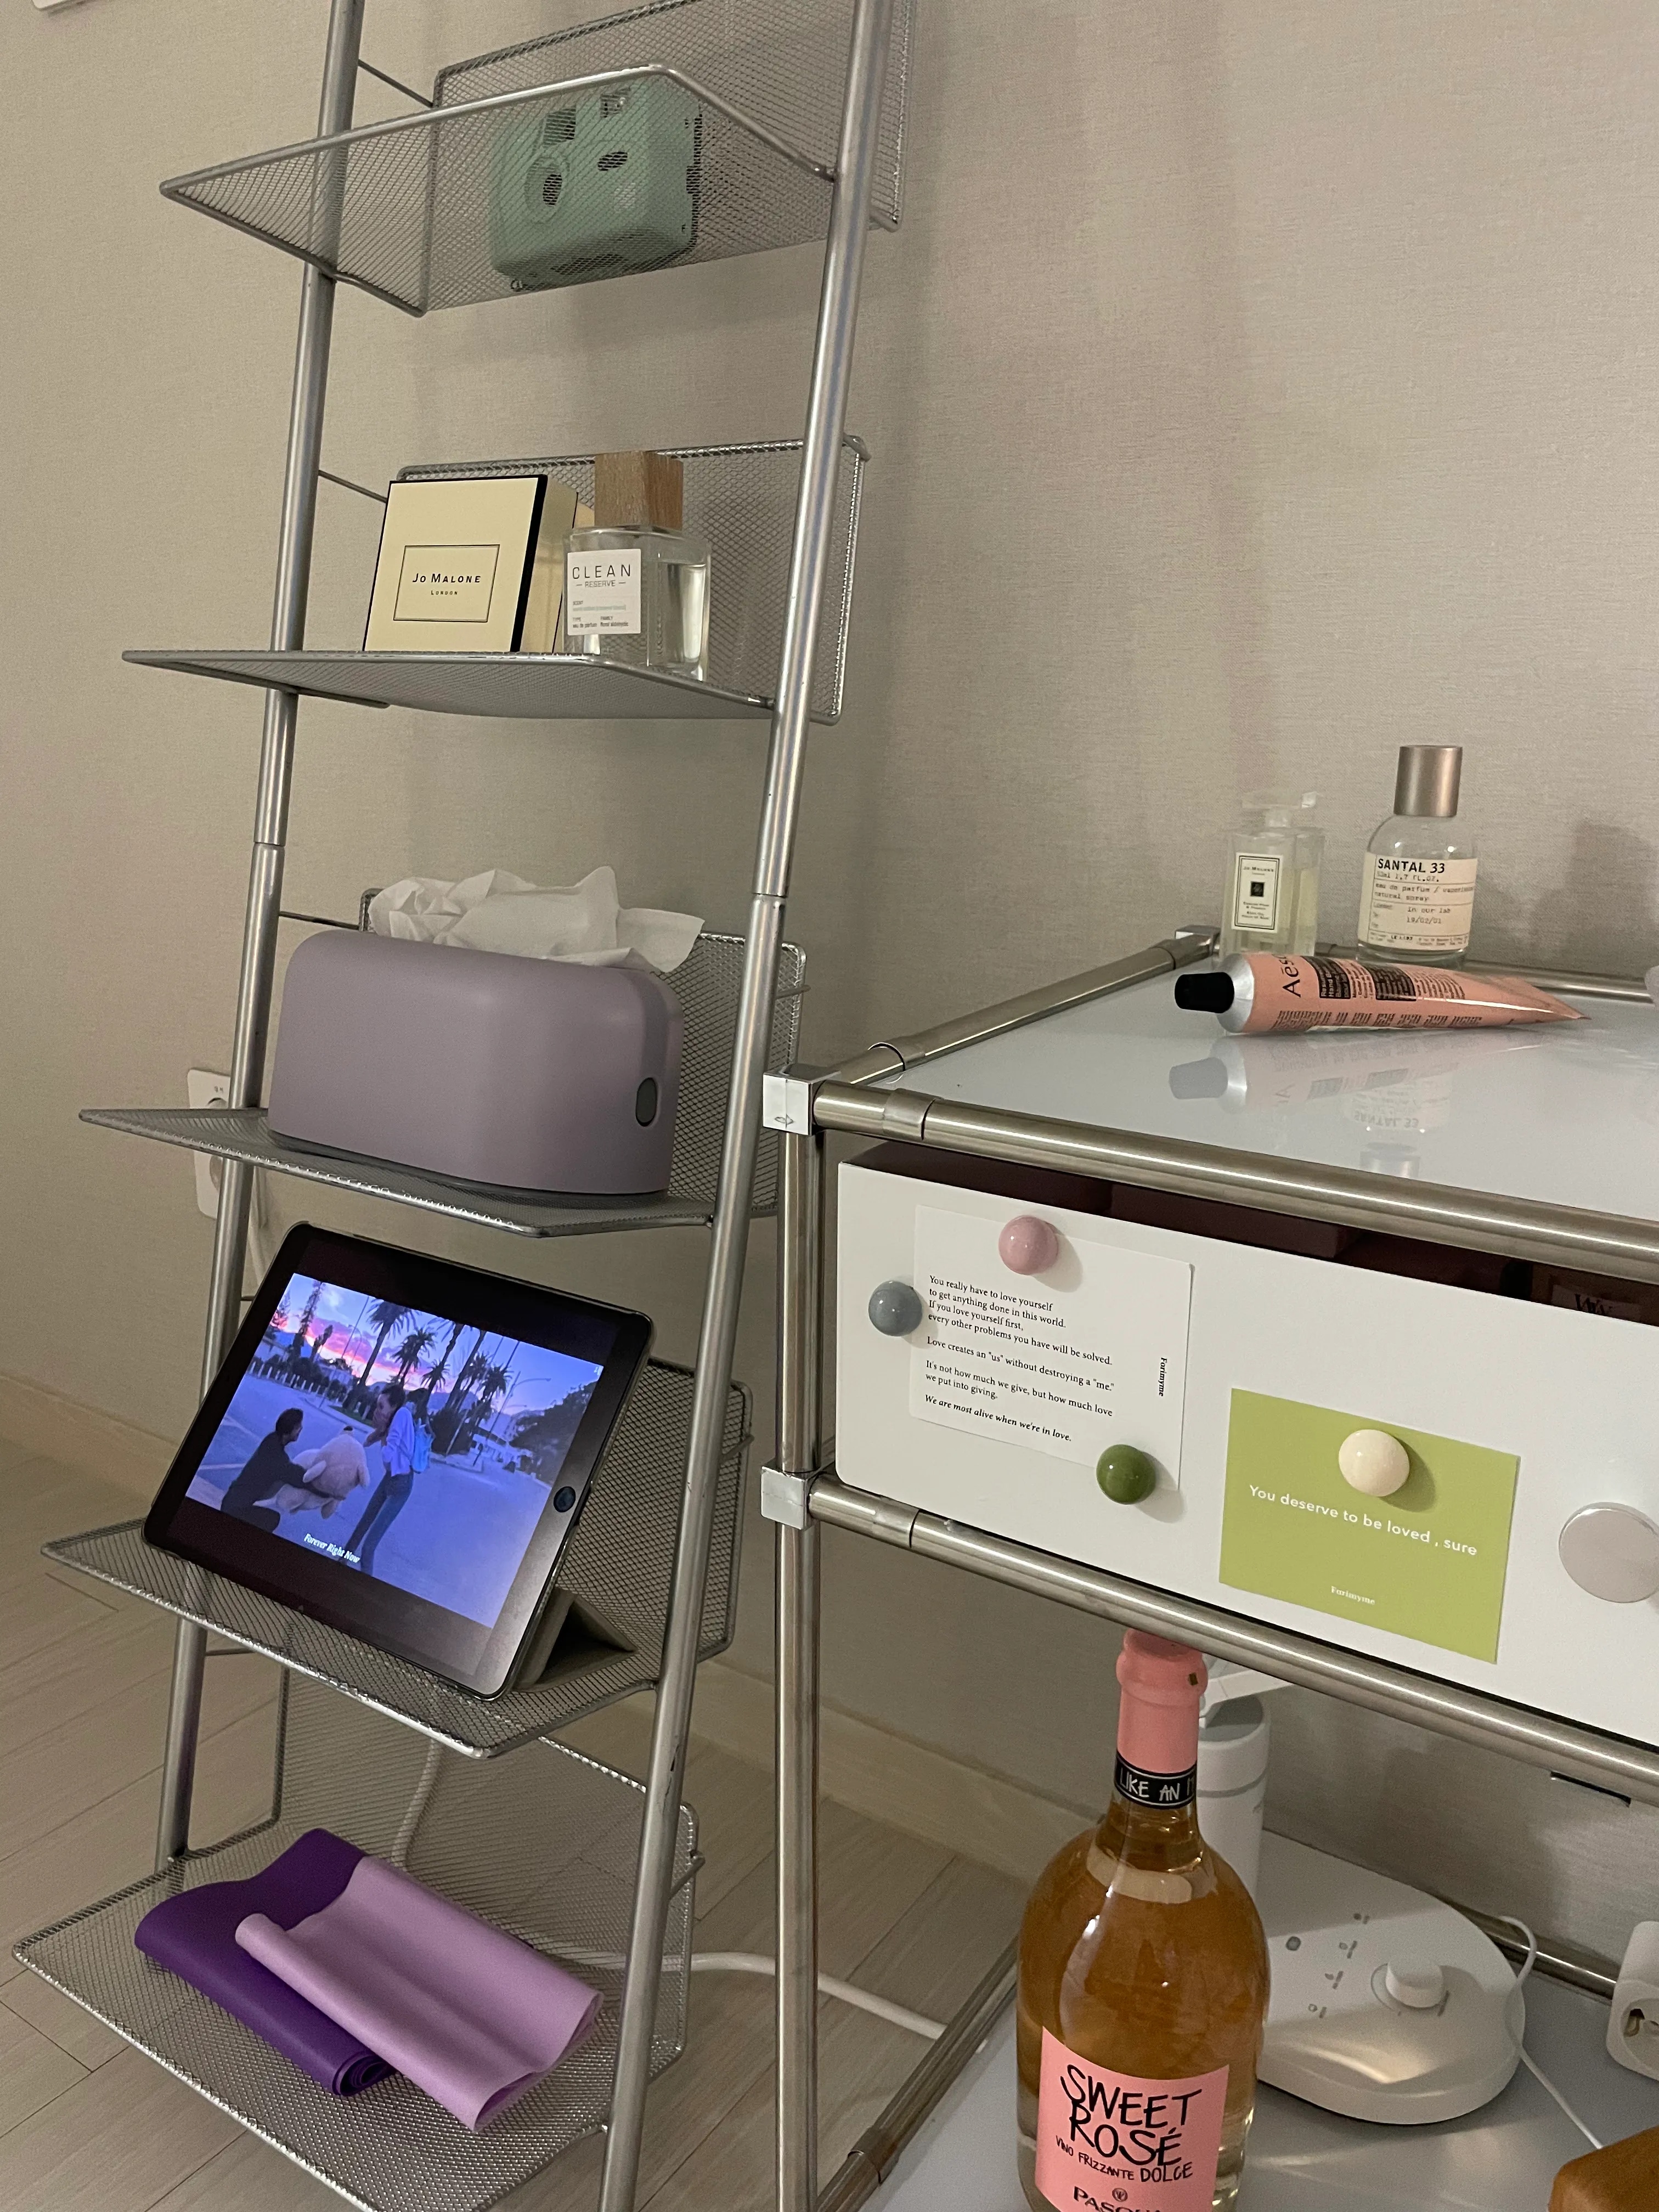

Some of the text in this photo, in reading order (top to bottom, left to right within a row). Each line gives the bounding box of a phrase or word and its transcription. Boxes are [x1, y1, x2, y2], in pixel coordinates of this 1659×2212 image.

[431, 573, 481, 583] MALONE
[572, 564, 630, 579] CLEAN
[585, 580, 616, 588] RESERVE
[1378, 858, 1445, 874] SANTAL 33
[929, 1275, 944, 1285] You
[946, 1281, 968, 1293] really
[970, 1284, 988, 1296] have
[1000, 1291, 1017, 1303] love
[1019, 1297, 1053, 1311] yourself
[939, 1292, 950, 1300] get
[953, 1295, 987, 1311] anything
[990, 1302, 1009, 1314] done
[1012, 1308, 1019, 1317] in
[1023, 1310, 1037, 1321] this
[1039, 1316, 1066, 1328] world.
[929, 1300, 1024, 1331] If you love yourself first,
[929, 1314, 1113, 1365] every other problems you have will be solved.
[927, 1336, 946, 1348] Love
[948, 1344, 974, 1356] creates
[988, 1351, 1003, 1362] "us"
[1005, 1357, 1037, 1372] without
[1039, 1365, 1084, 1386] destroying
[1093, 1378, 1114, 1391] "me."
[926, 1360, 1113, 1417] It's not how much we give, but how much love
[938, 1377, 951, 1385] put
[953, 1379, 968, 1390] into
[971, 1385, 997, 1400] giving.
[925, 1394, 1071, 1441] We are most alive when we're in love.
[1250, 1485, 1276, 1502] You
[1280, 1494, 1339, 1517] deserve
[1343, 1510, 1358, 1523] to
[1363, 1514, 1382, 1530] be
[1387, 1520, 1430, 1543] loved
[1443, 1539, 1477, 1555] sure
[303, 1533, 360, 1563] Forever Right Now
[1120, 1767, 1149, 1798] LIKE
[1159, 1783, 1180, 1801] AN
[1060, 2064, 1202, 2129] SWEET
[1069, 2101, 1182, 2166] ROSÉ
[1056, 2135, 1193, 2182] VINO FRIZZANTE DOLCE
